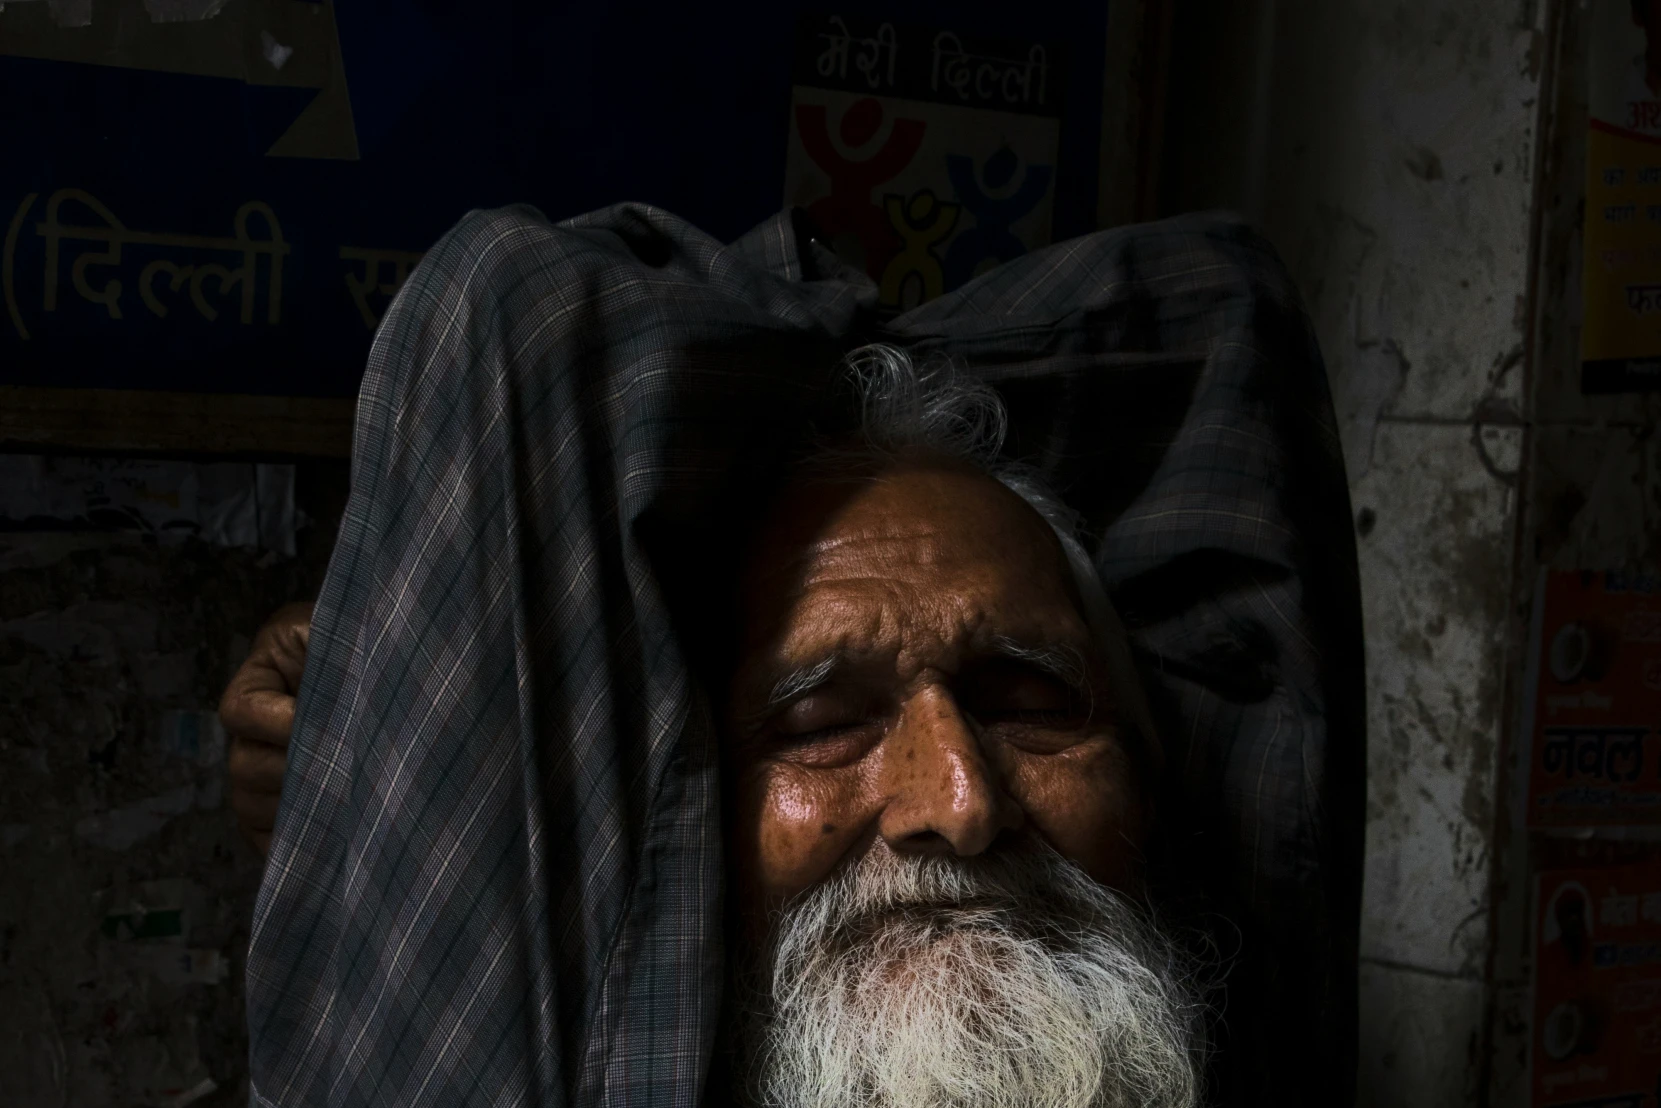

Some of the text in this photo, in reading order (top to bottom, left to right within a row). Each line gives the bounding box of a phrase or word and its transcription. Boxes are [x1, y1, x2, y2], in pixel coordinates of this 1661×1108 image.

[816, 15, 1051, 105] मेरी दिल्ली
[2, 188, 424, 340] (दिल्ली स
[1543, 728, 1650, 782] नवल
